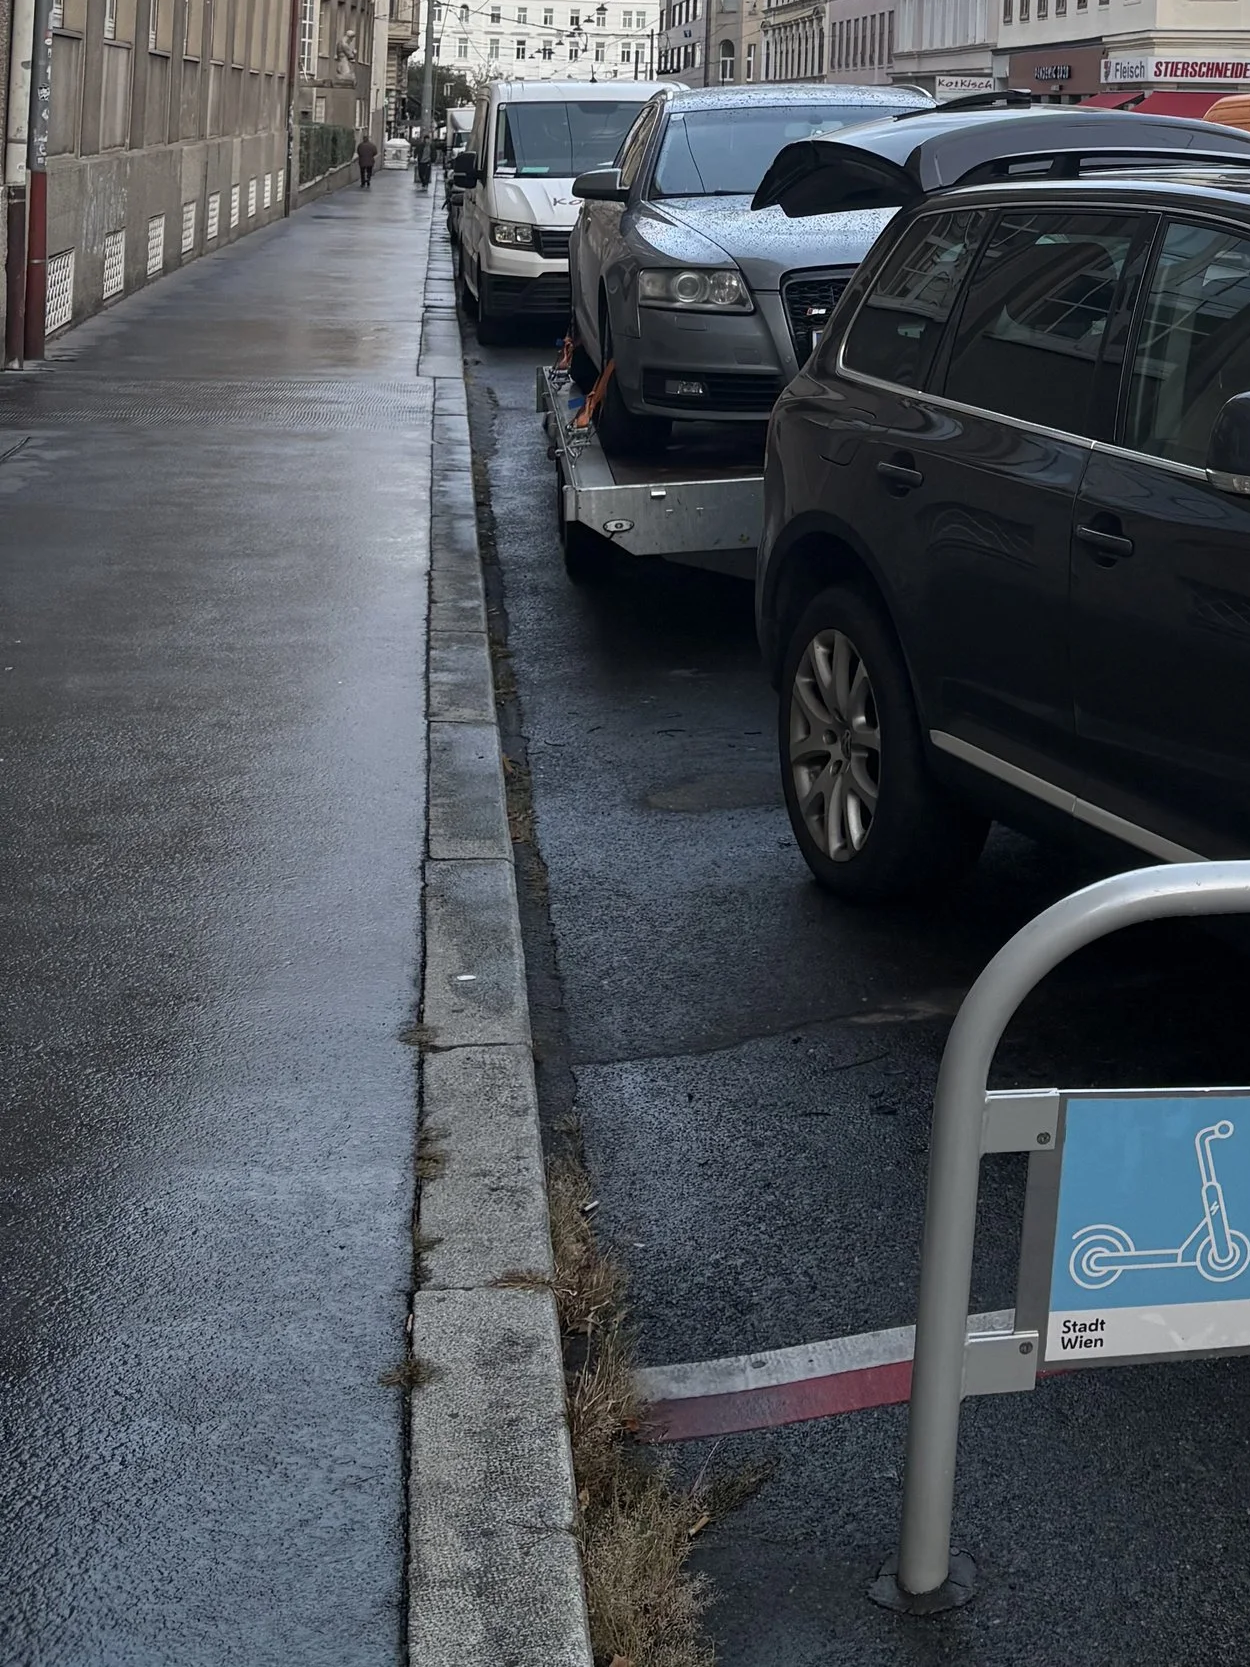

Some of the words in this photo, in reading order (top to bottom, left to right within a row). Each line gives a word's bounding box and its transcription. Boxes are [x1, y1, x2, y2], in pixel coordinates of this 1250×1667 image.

[1114, 61, 1146, 79] Fleisch
[1062, 1318, 1106, 1334] Stadt
[1061, 1335, 1104, 1350] Wien
